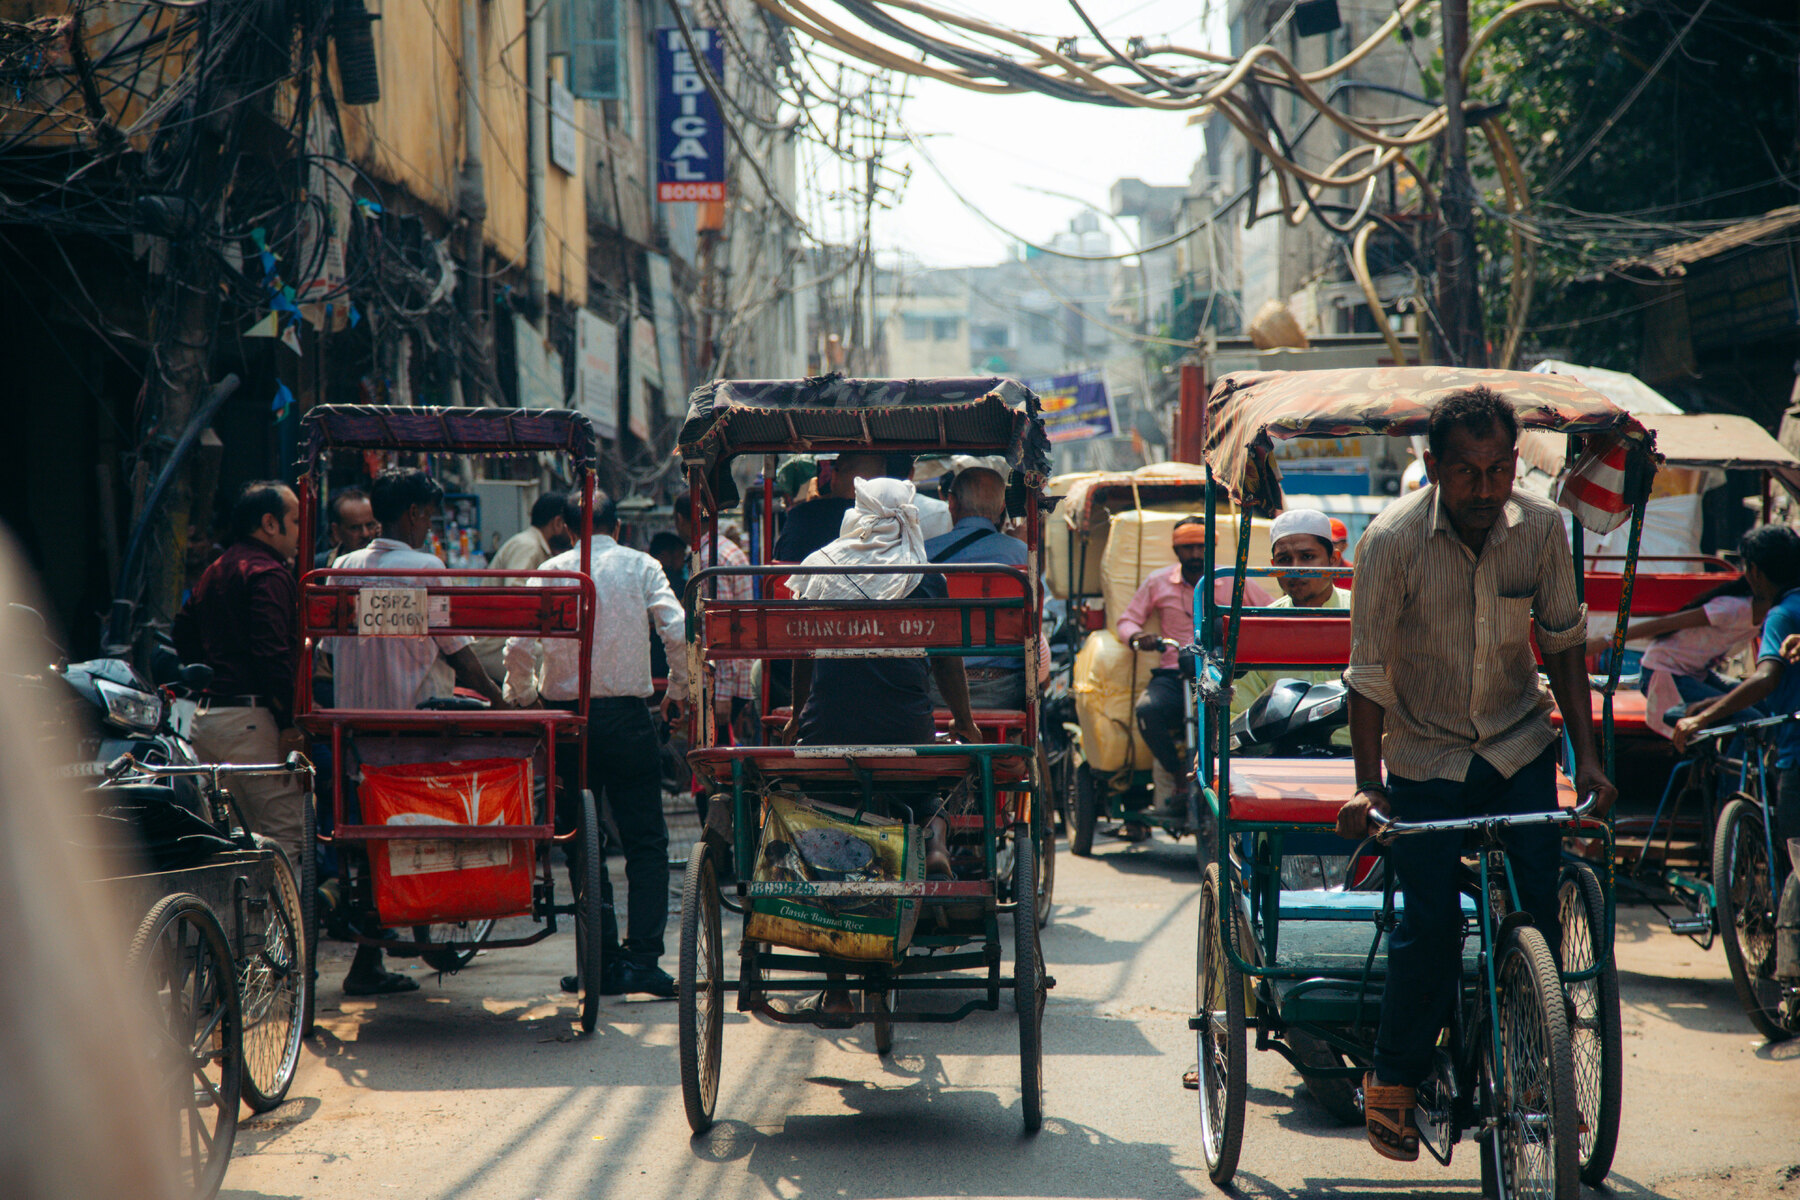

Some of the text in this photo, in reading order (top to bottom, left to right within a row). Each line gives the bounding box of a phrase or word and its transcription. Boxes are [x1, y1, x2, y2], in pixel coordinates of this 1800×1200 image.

[668, 30, 710, 181] MEDICAL
[660, 184, 723, 200] BOOKS
[786, 619, 935, 637] CHANCHAL 097
[780, 905, 809, 920] Classic
[843, 919, 864, 931] Rice
